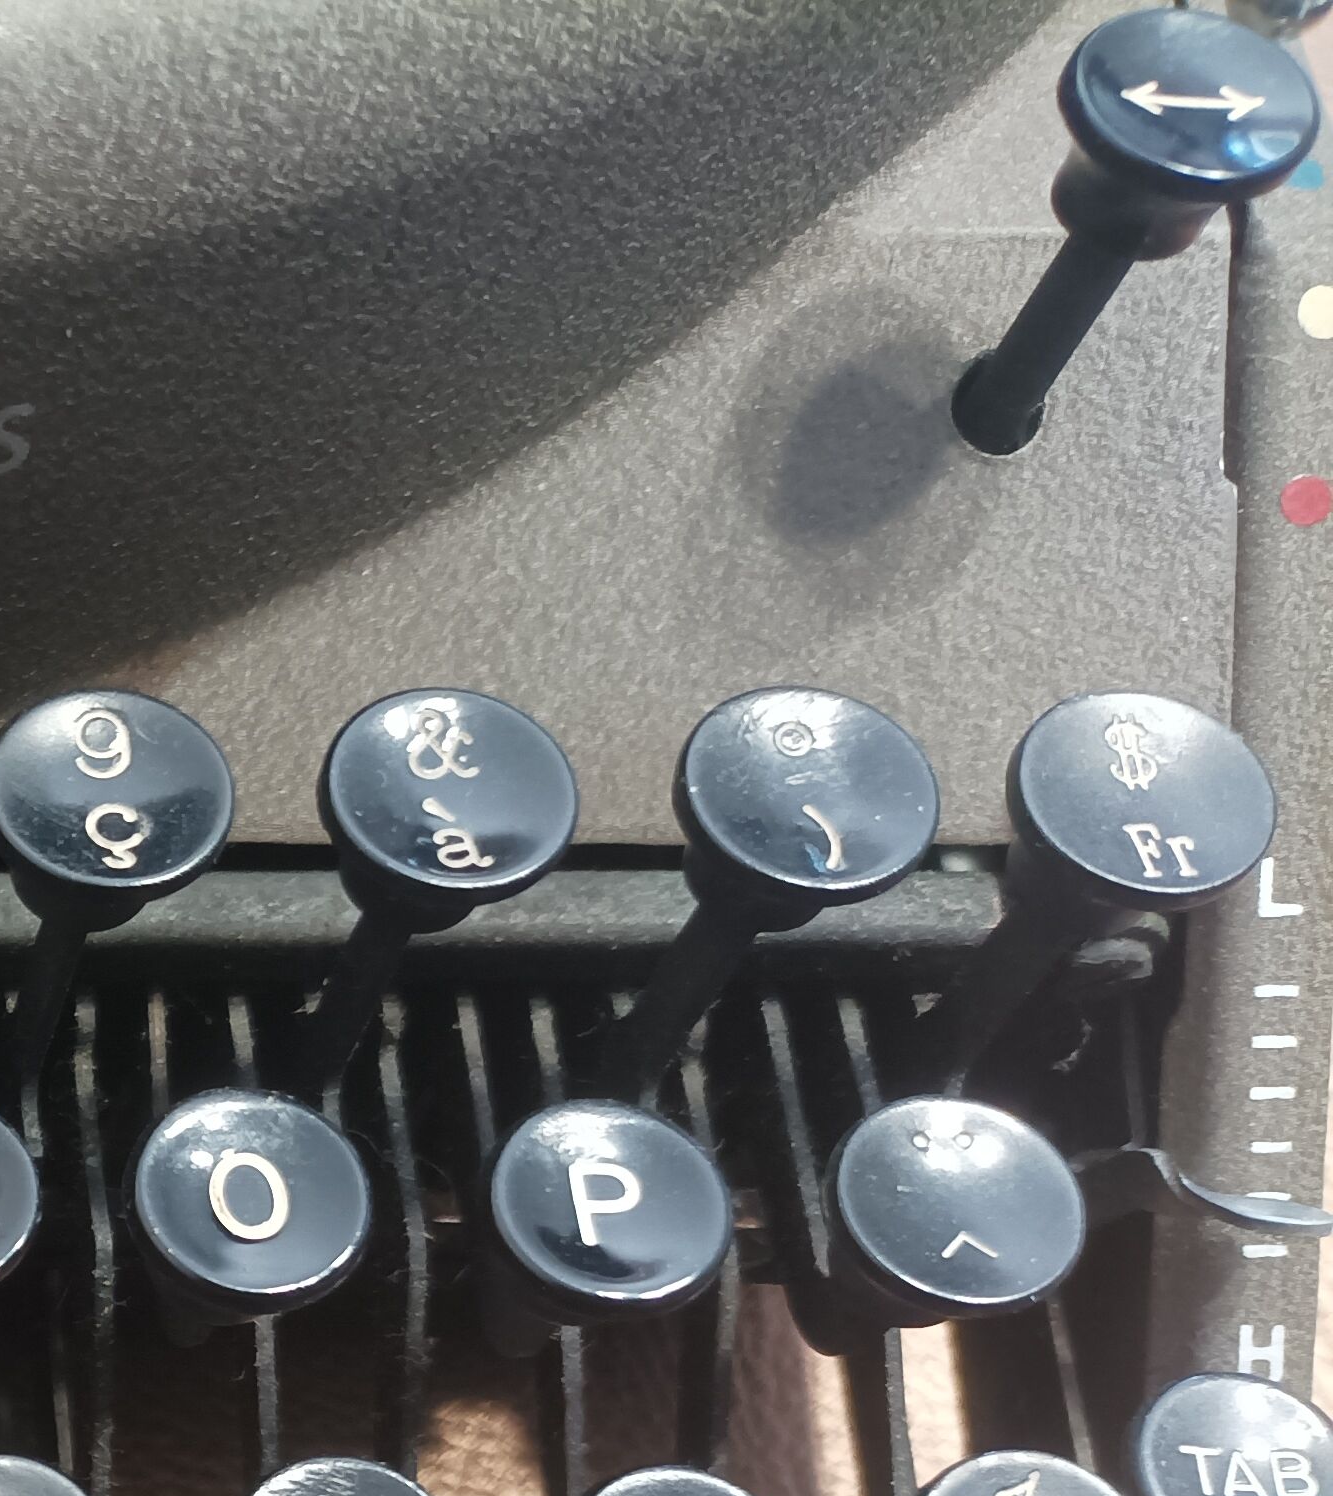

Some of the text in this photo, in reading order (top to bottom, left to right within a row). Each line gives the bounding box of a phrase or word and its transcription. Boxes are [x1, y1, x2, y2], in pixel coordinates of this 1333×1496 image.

[73, 708, 133, 780] 9
[408, 707, 481, 781] &
[1102, 713, 1159, 791] $
[83, 802, 146, 869] ç
[421, 796, 495, 869] à
[1123, 823, 1200, 878] Fr
[1257, 856, 1303, 918] L
[208, 1149, 291, 1240] O
[566, 1161, 641, 1246] P
[1238, 1323, 1286, 1384] H
